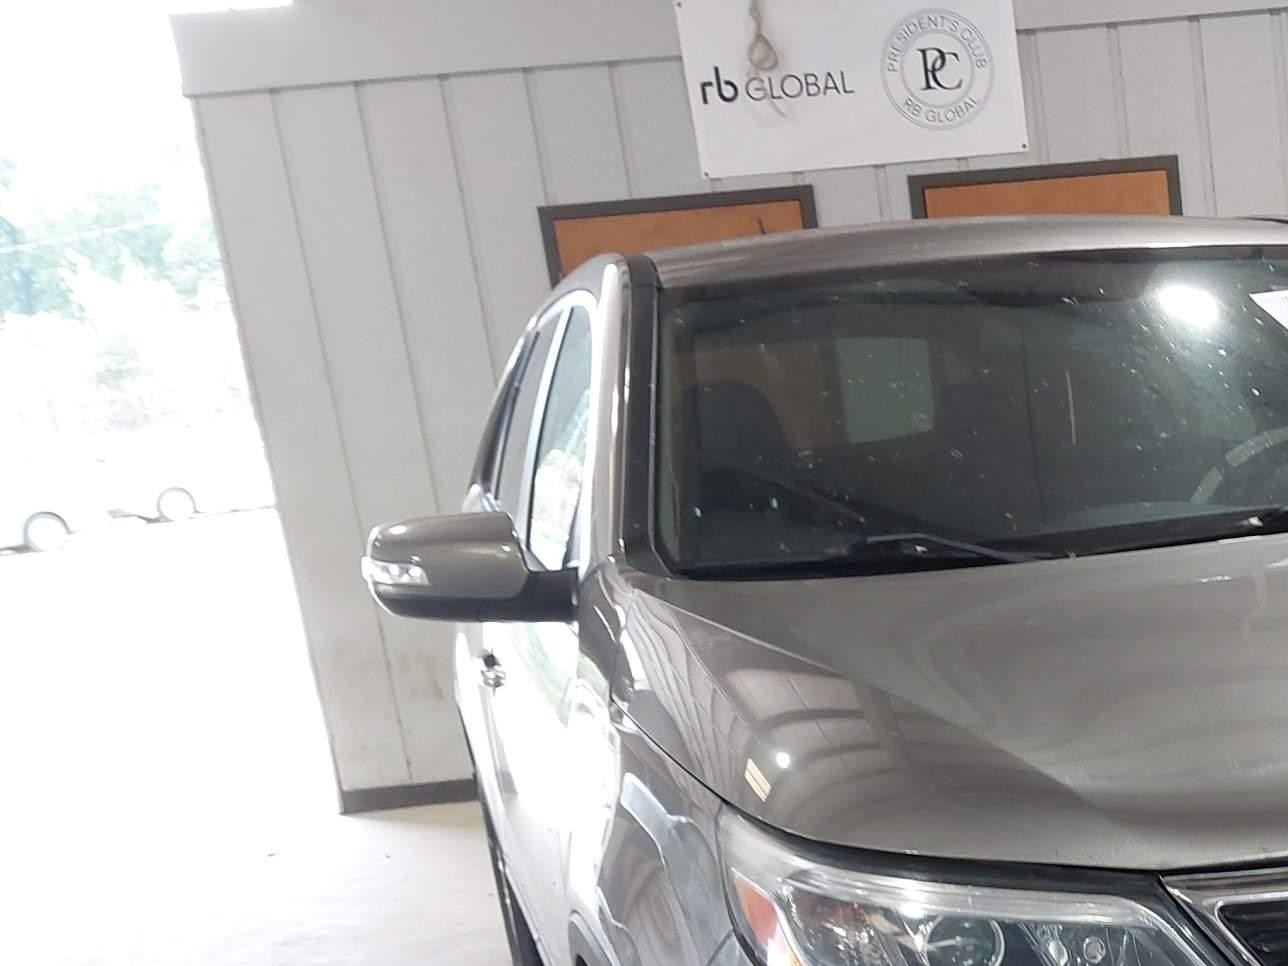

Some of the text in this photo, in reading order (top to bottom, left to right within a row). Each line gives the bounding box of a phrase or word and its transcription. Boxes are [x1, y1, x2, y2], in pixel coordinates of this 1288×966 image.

[960, 27, 988, 69] CLUB
[700, 66, 855, 105] rb GLOBAL
[925, 96, 979, 123] GLOBAL
